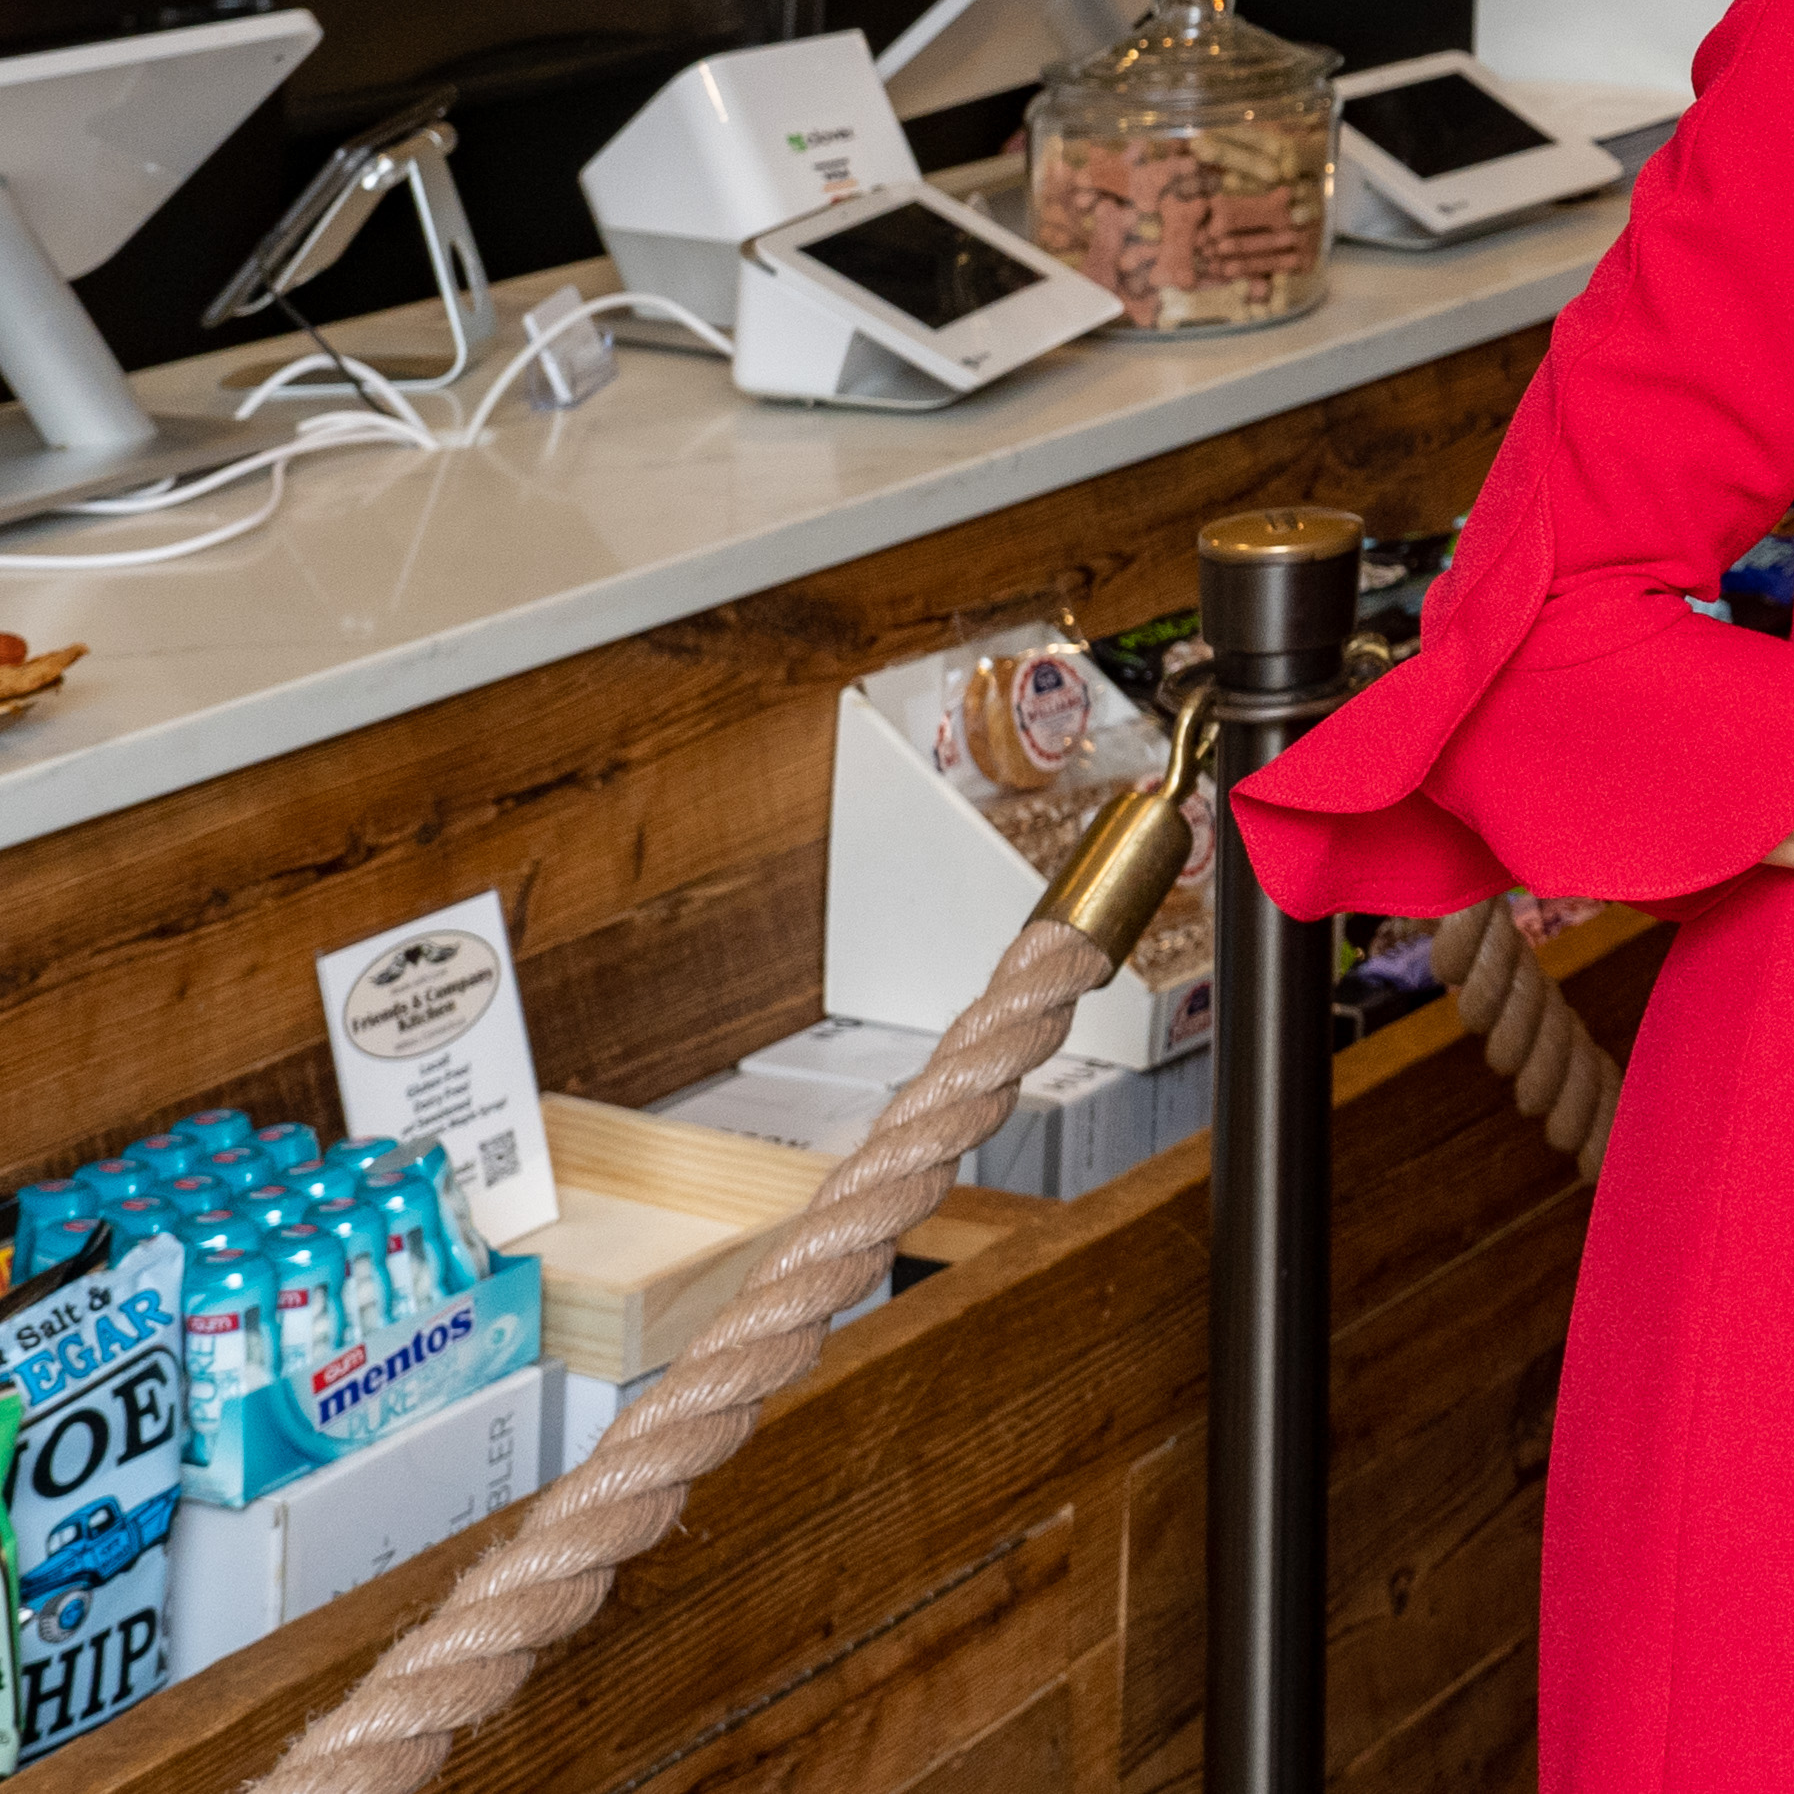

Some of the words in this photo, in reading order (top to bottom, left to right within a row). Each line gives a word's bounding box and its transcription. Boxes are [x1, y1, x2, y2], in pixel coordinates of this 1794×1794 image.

[0, 1289, 174, 1408] EGAR
[16, 1301, 83, 1352] Salt
[88, 1284, 112, 1312] &
[318, 1306, 474, 1427] mentos
[486, 1411, 515, 1512] BLER
[20, 1607, 173, 1746] HIP
